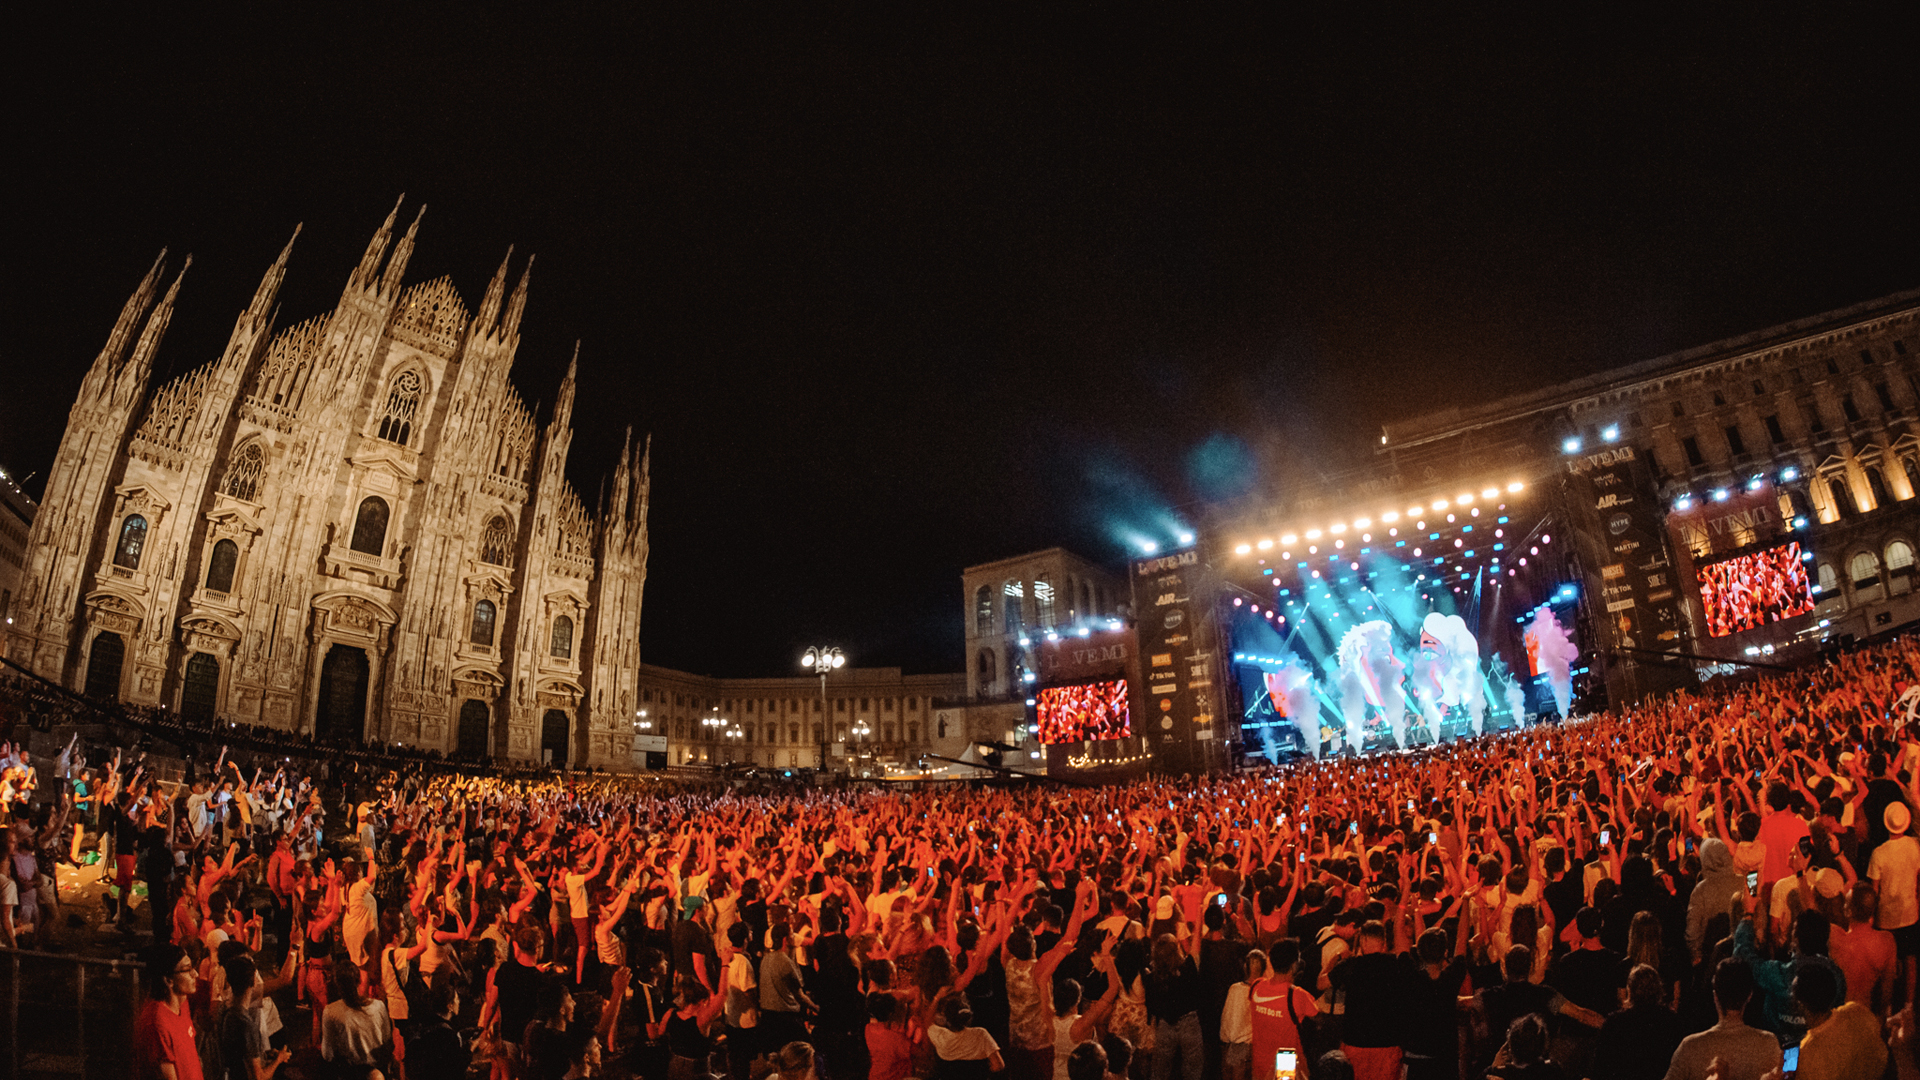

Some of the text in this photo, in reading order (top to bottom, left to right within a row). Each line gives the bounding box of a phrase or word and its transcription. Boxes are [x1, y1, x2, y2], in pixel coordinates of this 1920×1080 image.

[1610, 517, 1629, 528] HYPE
[1613, 541, 1640, 552] MARTINI
[1602, 564, 1623, 578] DIESEL
